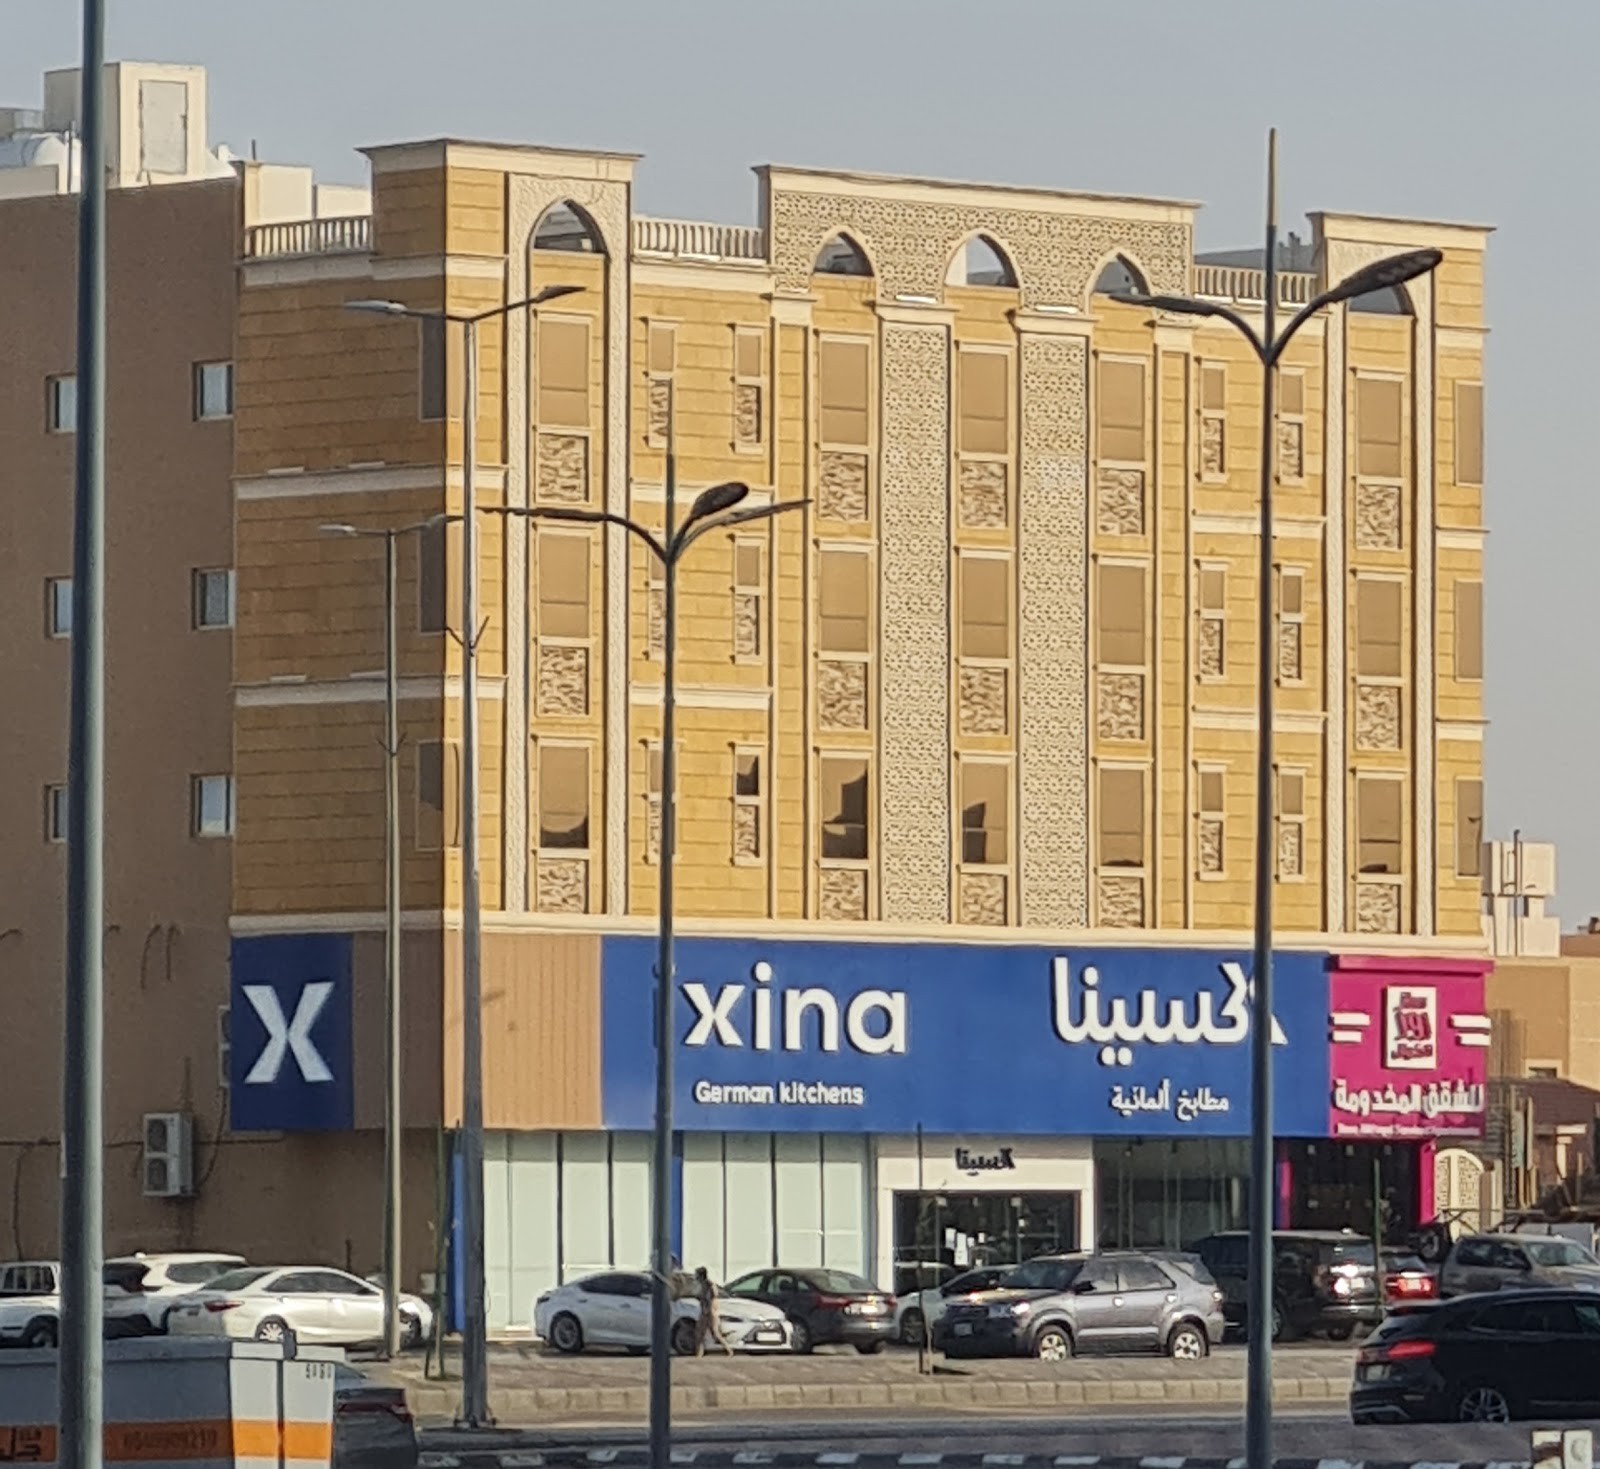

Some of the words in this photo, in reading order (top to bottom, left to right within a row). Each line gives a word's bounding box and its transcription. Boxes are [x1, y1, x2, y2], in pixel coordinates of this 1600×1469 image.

[681, 961, 907, 1054] xina
[695, 1081, 775, 1105] German
[779, 1081, 864, 1105] kitchens
[1111, 1078, 1170, 1117] ألمانية
[1176, 1088, 1230, 1121] مطابخ
[1334, 1078, 1421, 1117] المخدومة
